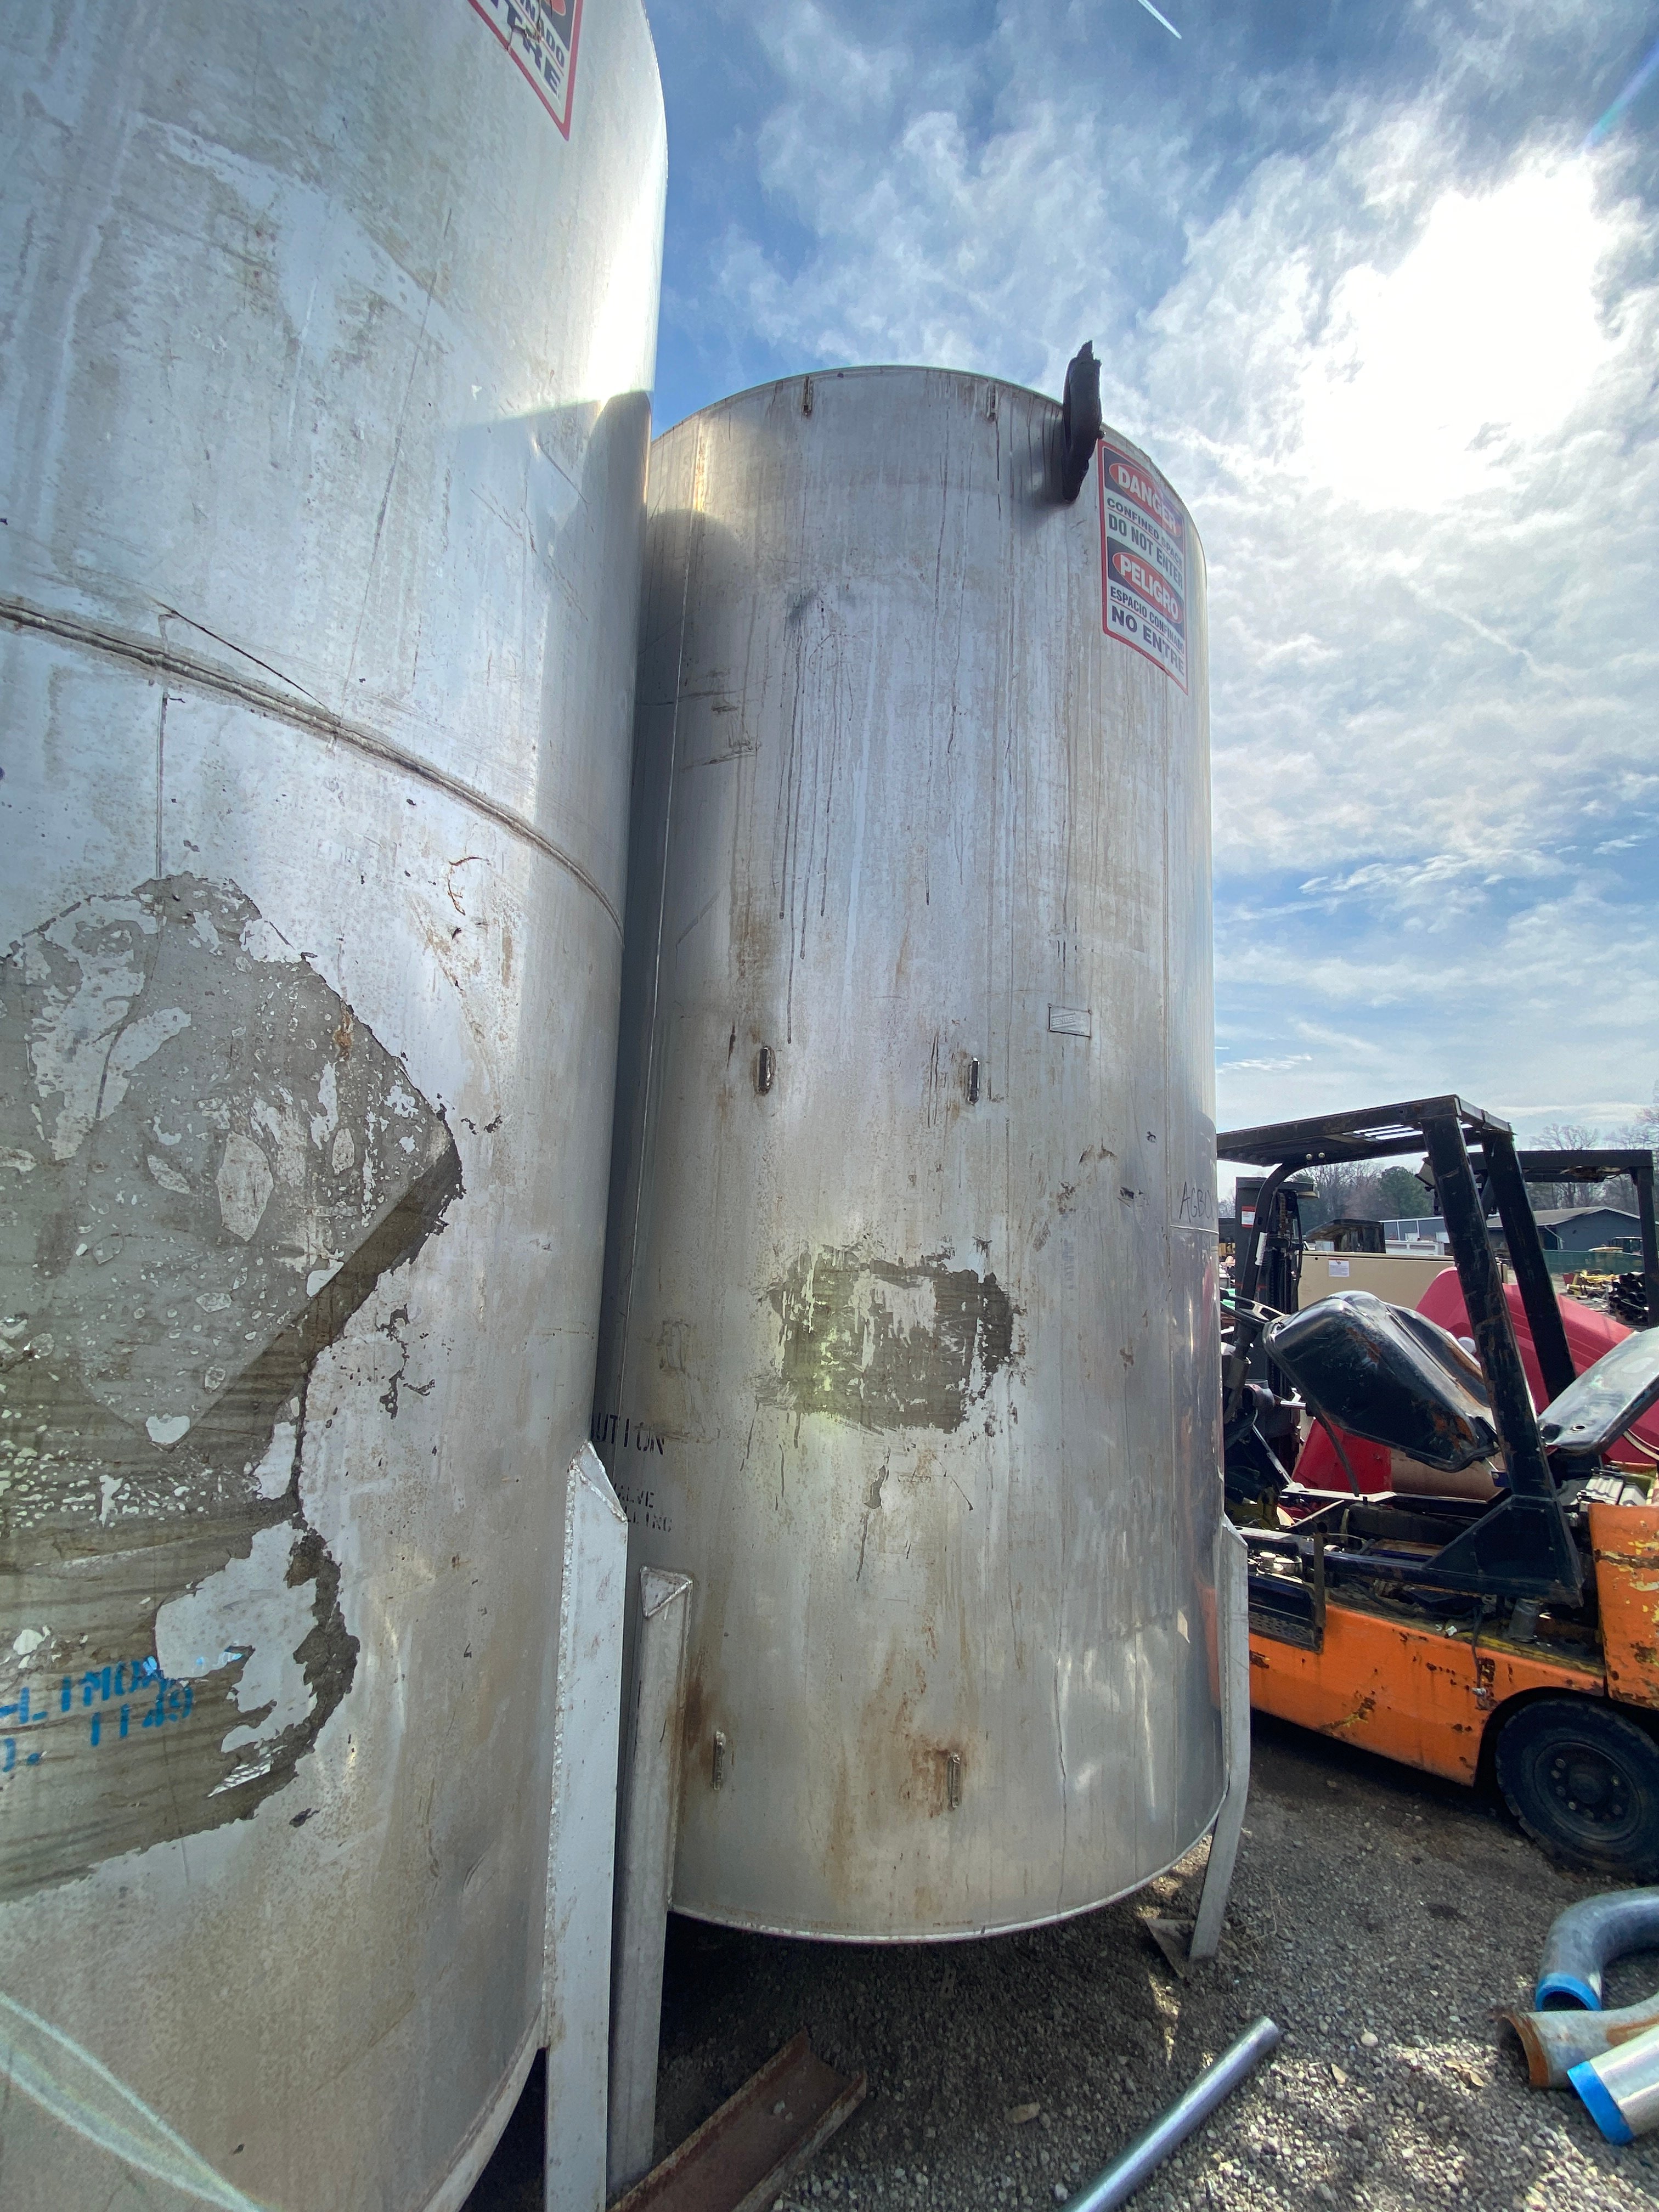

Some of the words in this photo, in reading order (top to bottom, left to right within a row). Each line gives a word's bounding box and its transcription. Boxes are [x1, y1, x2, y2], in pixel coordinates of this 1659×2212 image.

[1107, 497, 1160, 540] CONFINED
[1161, 536, 1183, 570] SPACE
[1118, 465, 1177, 535] DANGER
[1108, 513, 1127, 537] DO
[1131, 526, 1154, 556] NOT
[1156, 546, 1183, 590] ENTER
[1110, 585, 1147, 618] ESPACIO
[1149, 611, 1184, 655] CONFINADO
[1120, 554, 1178, 620] PELIGRO
[1111, 605, 1137, 633] NO
[1143, 624, 1184, 676] ENTRE
[591, 1412, 664, 1455] UTION
